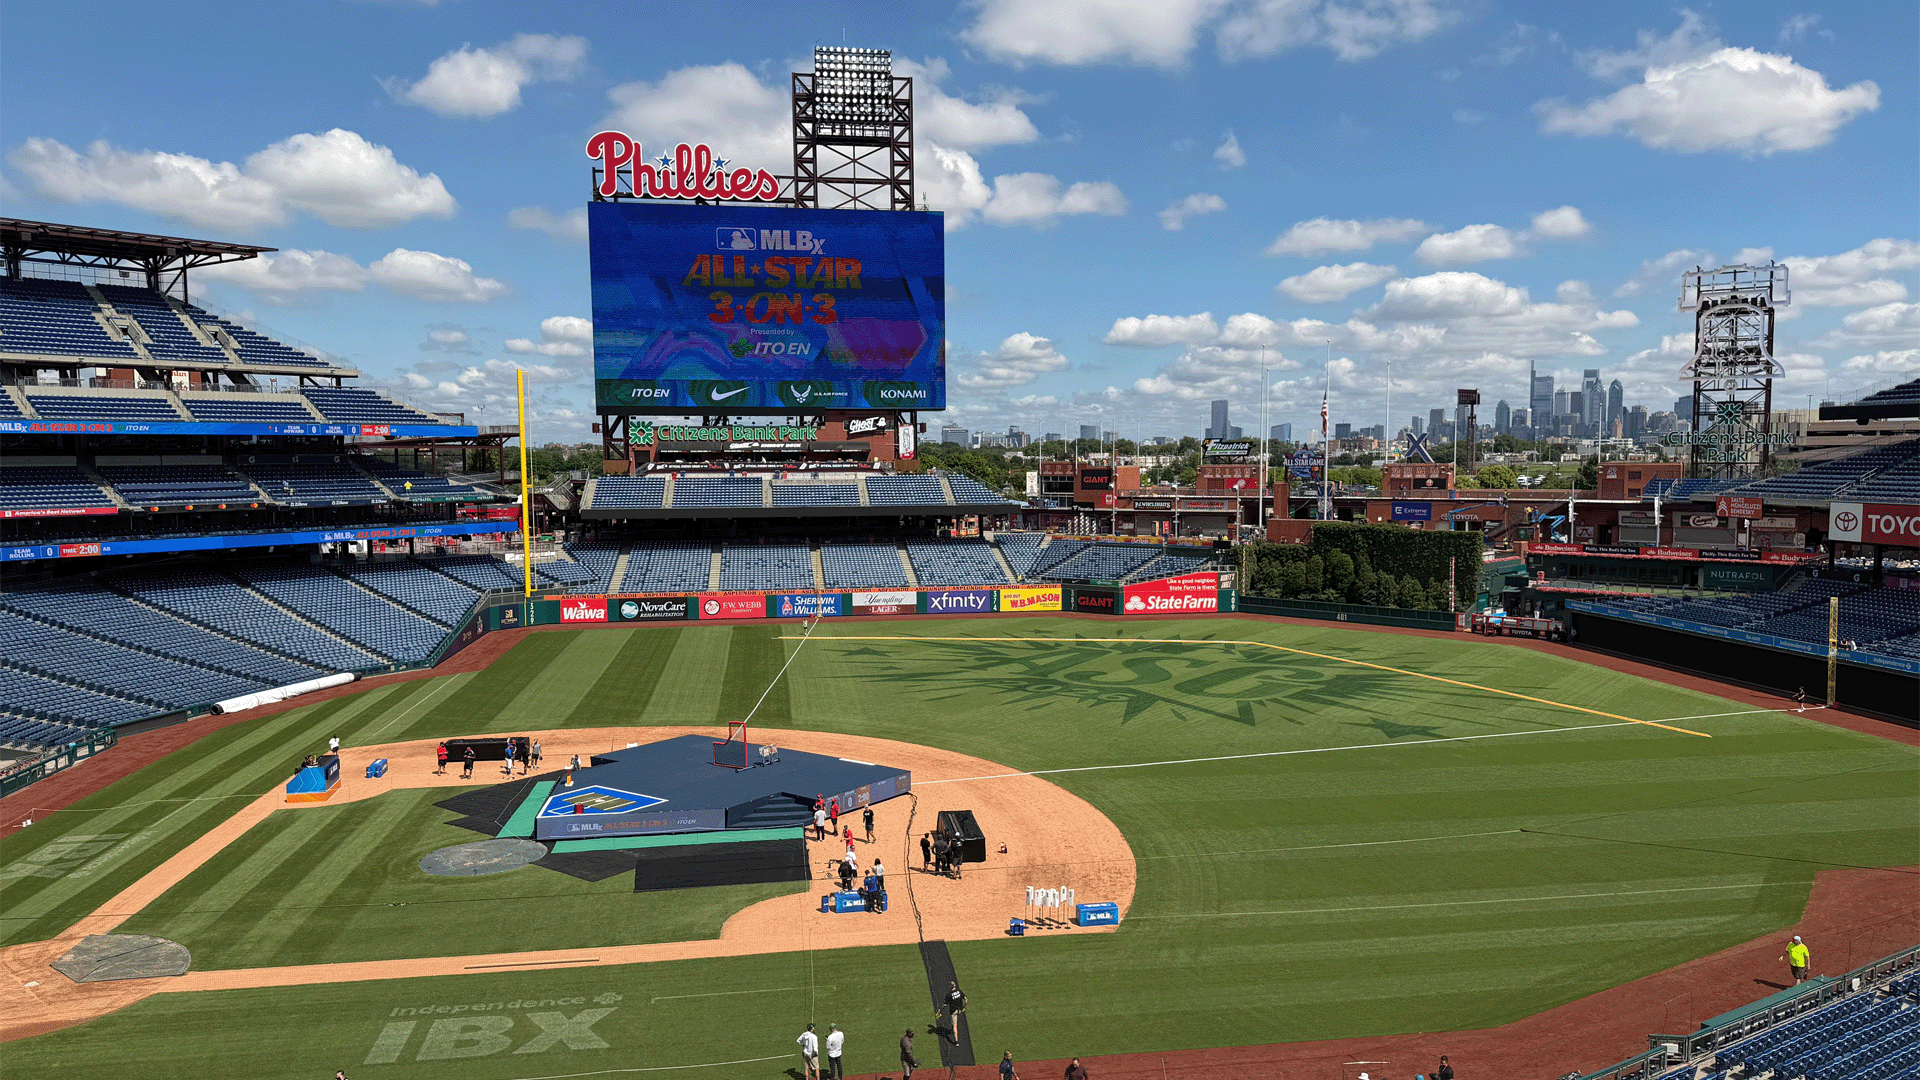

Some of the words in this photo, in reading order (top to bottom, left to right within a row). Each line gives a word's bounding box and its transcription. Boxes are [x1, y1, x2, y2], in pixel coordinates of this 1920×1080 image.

[587, 131, 780, 200] Phillies
[682, 254, 755, 287] ALL
[764, 256, 863, 289] STAR
[708, 291, 837, 325] 3-ON-3
[750, 328, 785, 336] Presented
[754, 342, 785, 355] ITO
[787, 343, 811, 355] EN
[631, 388, 653, 398] ITO
[654, 389, 670, 398] EN
[880, 390, 926, 399] KONAMI
[374, 426, 388, 434] 2:00
[849, 417, 880, 433] GHOST
[658, 424, 729, 441] Citizens
[732, 424, 777, 441] Bank
[778, 425, 817, 441] Park
[1667, 430, 1741, 445] Citizens
[1744, 429, 1791, 444] Bank
[1707, 447, 1747, 462] Park
[46, 547, 53, 556] 0
[79, 545, 98, 554] 2:00
[1544, 544, 1578, 552] Budweiser
[1711, 570, 1765, 580] NUTRAFOL
[640, 601, 686, 612] NovaCare
[738, 601, 762, 609] WEBB
[930, 592, 986, 610] xfinity
[1078, 596, 1114, 607] GIANT
[563, 607, 606, 620] Wawa
[871, 605, 898, 613] LAGER
[1336, 613, 1347, 621] 401
[388, 995, 586, 1017] Independence
[362, 1006, 620, 1065] IBX
